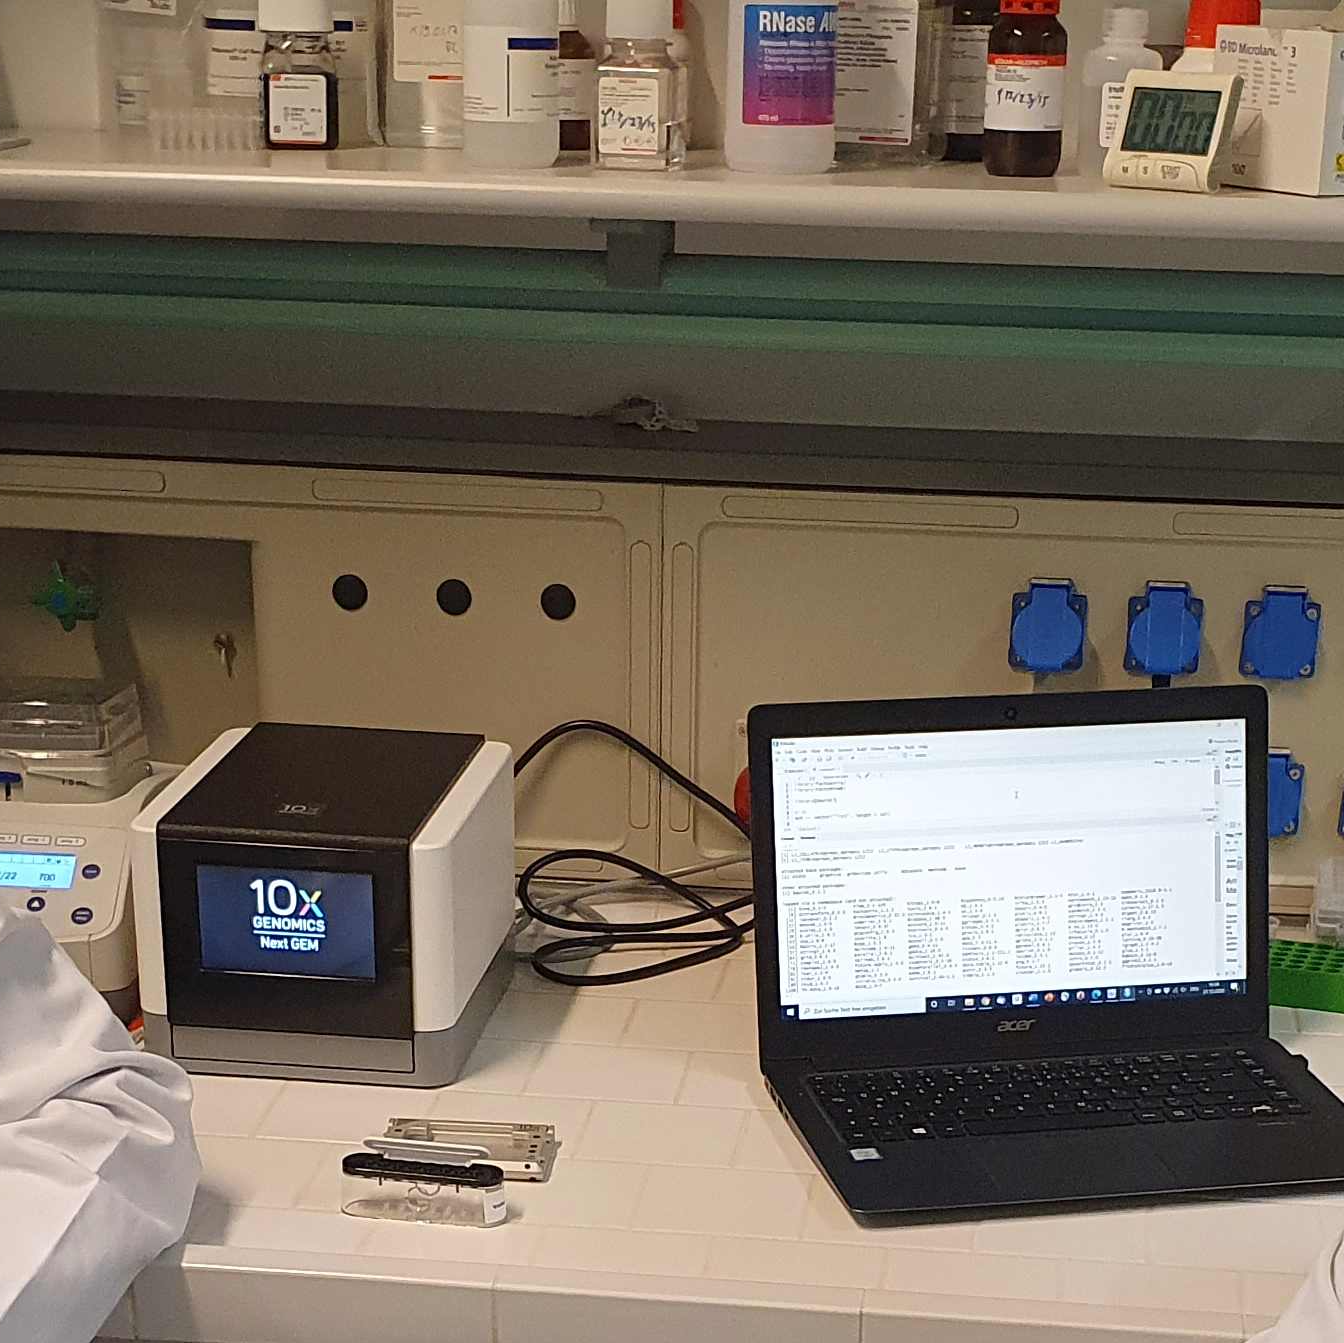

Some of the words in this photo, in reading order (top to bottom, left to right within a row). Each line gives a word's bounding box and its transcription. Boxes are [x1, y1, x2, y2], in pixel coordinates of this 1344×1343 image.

[759, 10, 816, 33] RNase
[250, 879, 324, 917] 10x
[253, 916, 326, 932] GENOMICS
[260, 936, 289, 950] Next
[290, 937, 319, 951] GEM
[997, 1019, 1037, 1032] acer
